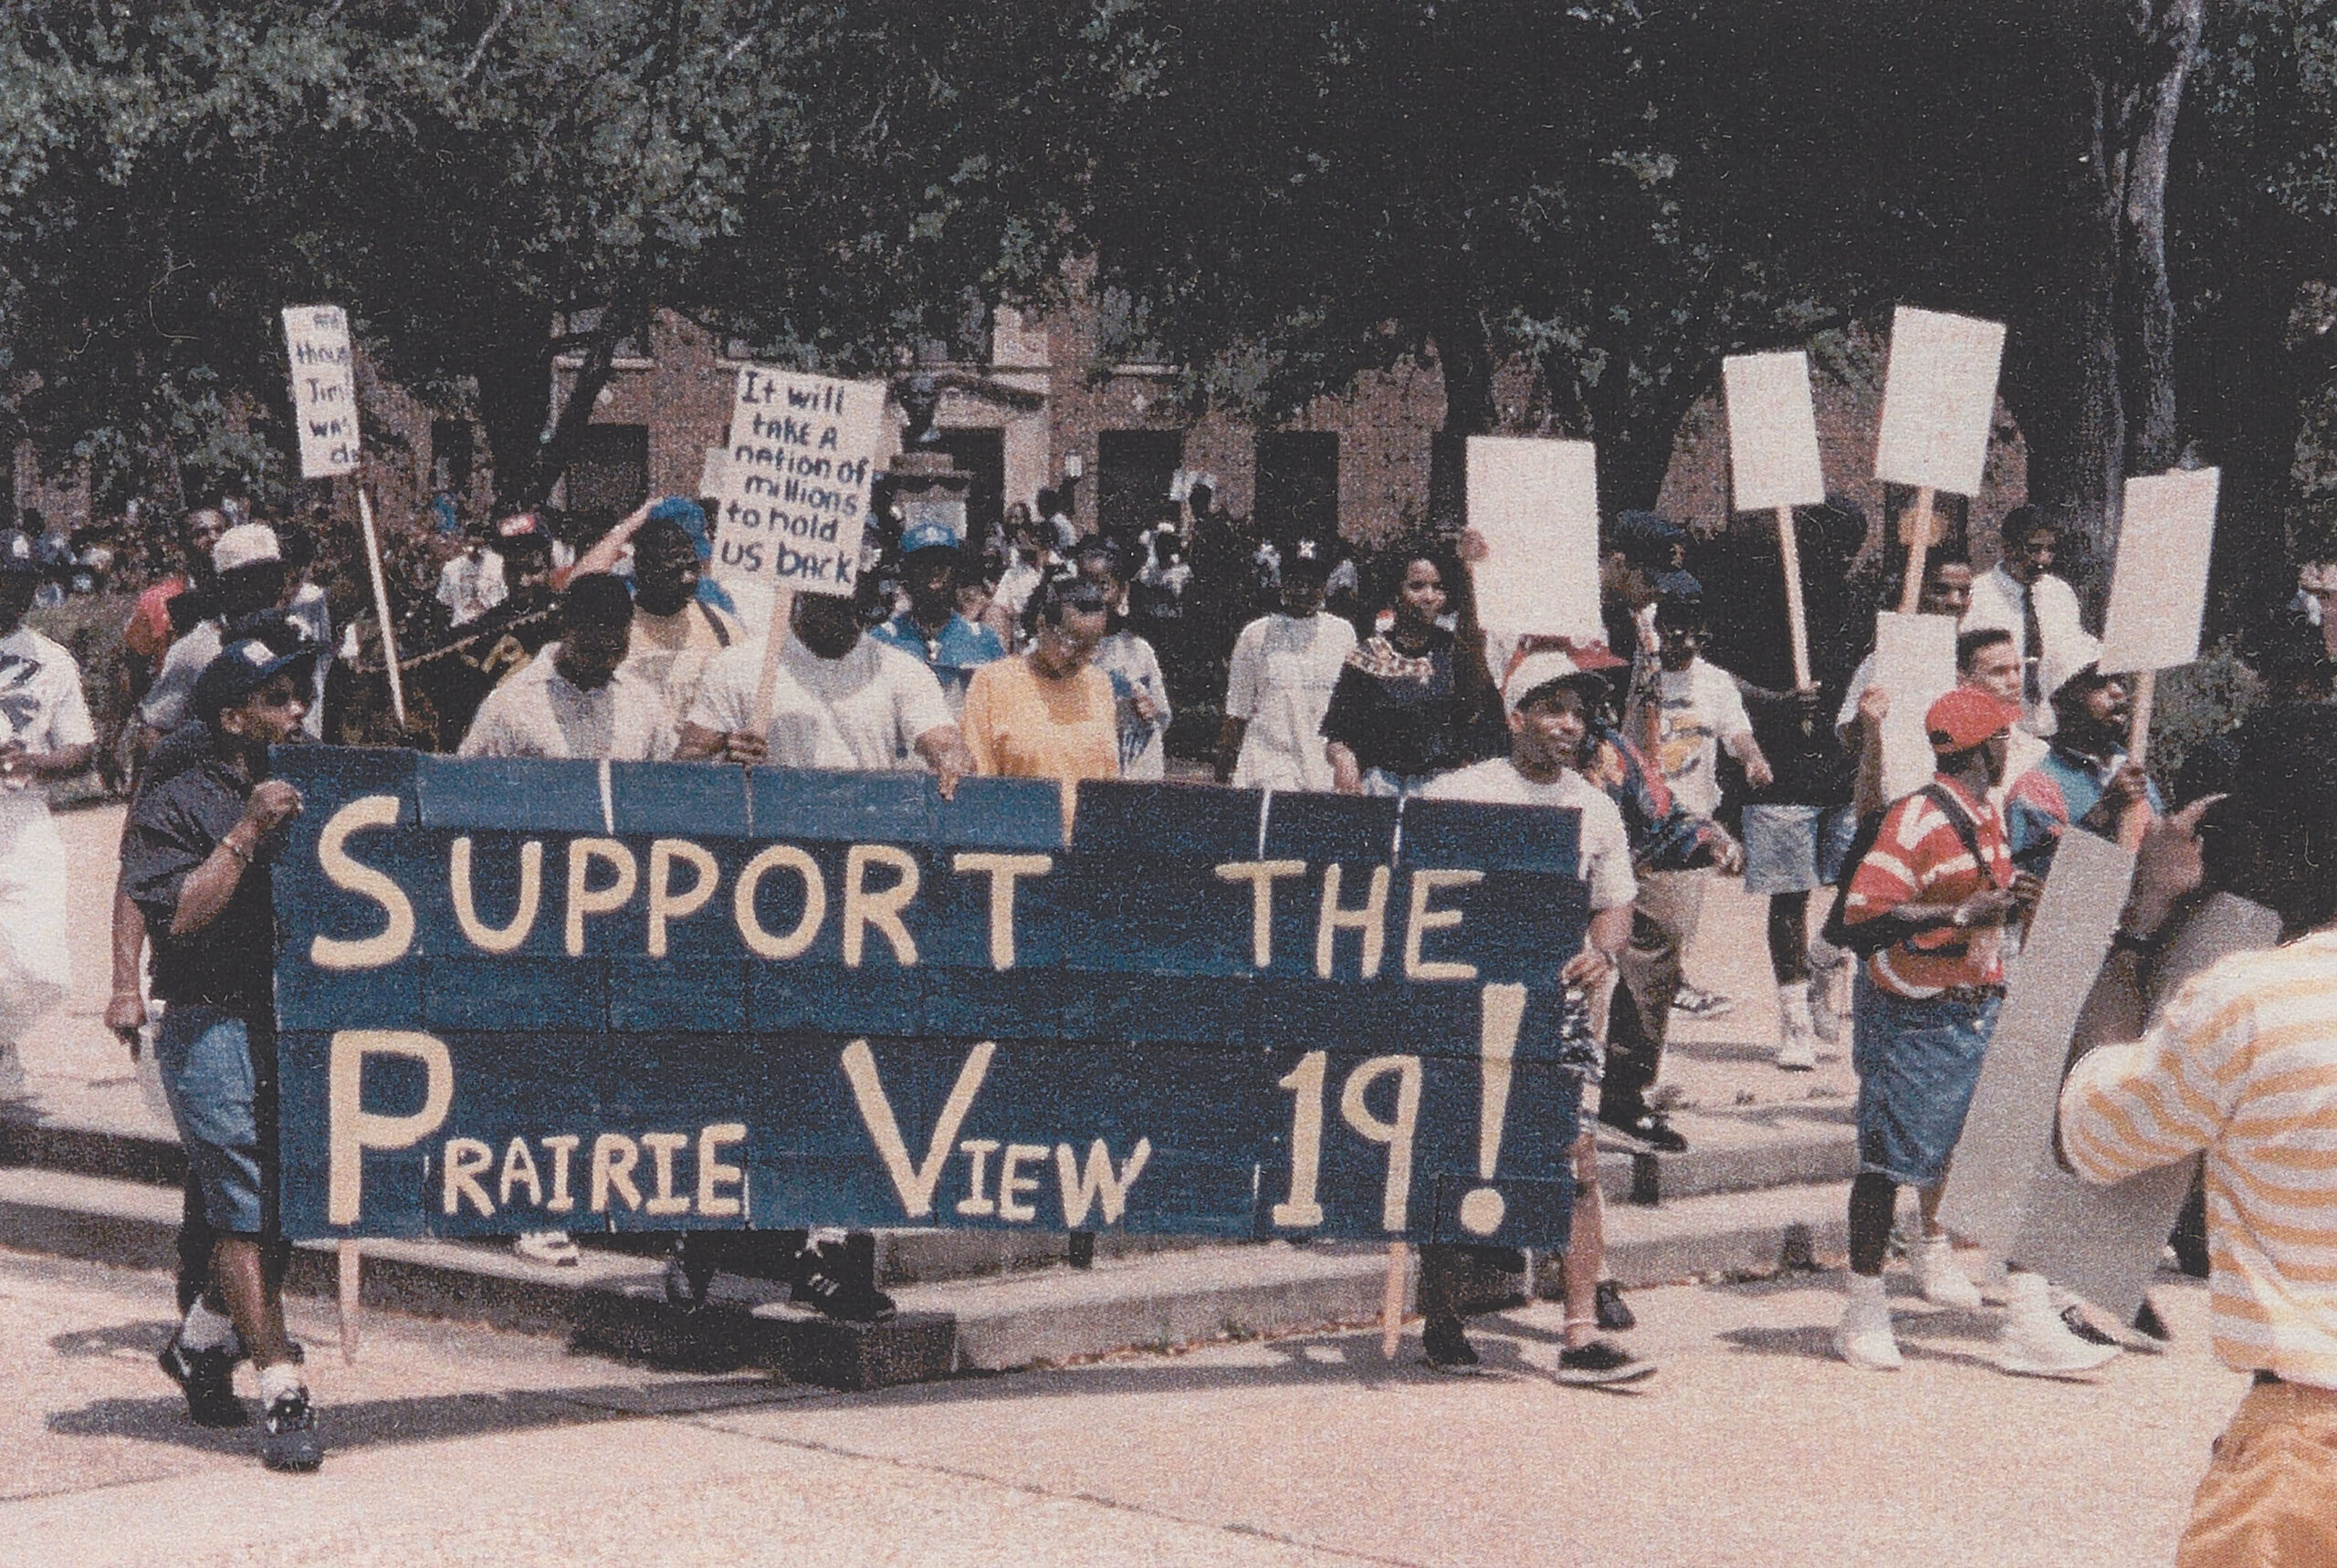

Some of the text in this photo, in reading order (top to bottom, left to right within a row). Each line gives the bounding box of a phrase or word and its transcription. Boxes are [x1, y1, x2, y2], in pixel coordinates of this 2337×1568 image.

[742, 370, 845, 416] It will
[735, 444, 870, 486] nation of
[744, 474, 859, 517] millions
[727, 498, 839, 544] to hold
[310, 795, 1486, 981] SUPPORT THE
[329, 1030, 749, 1227] PRAIRIE
[841, 1038, 1152, 1228] VIEW
